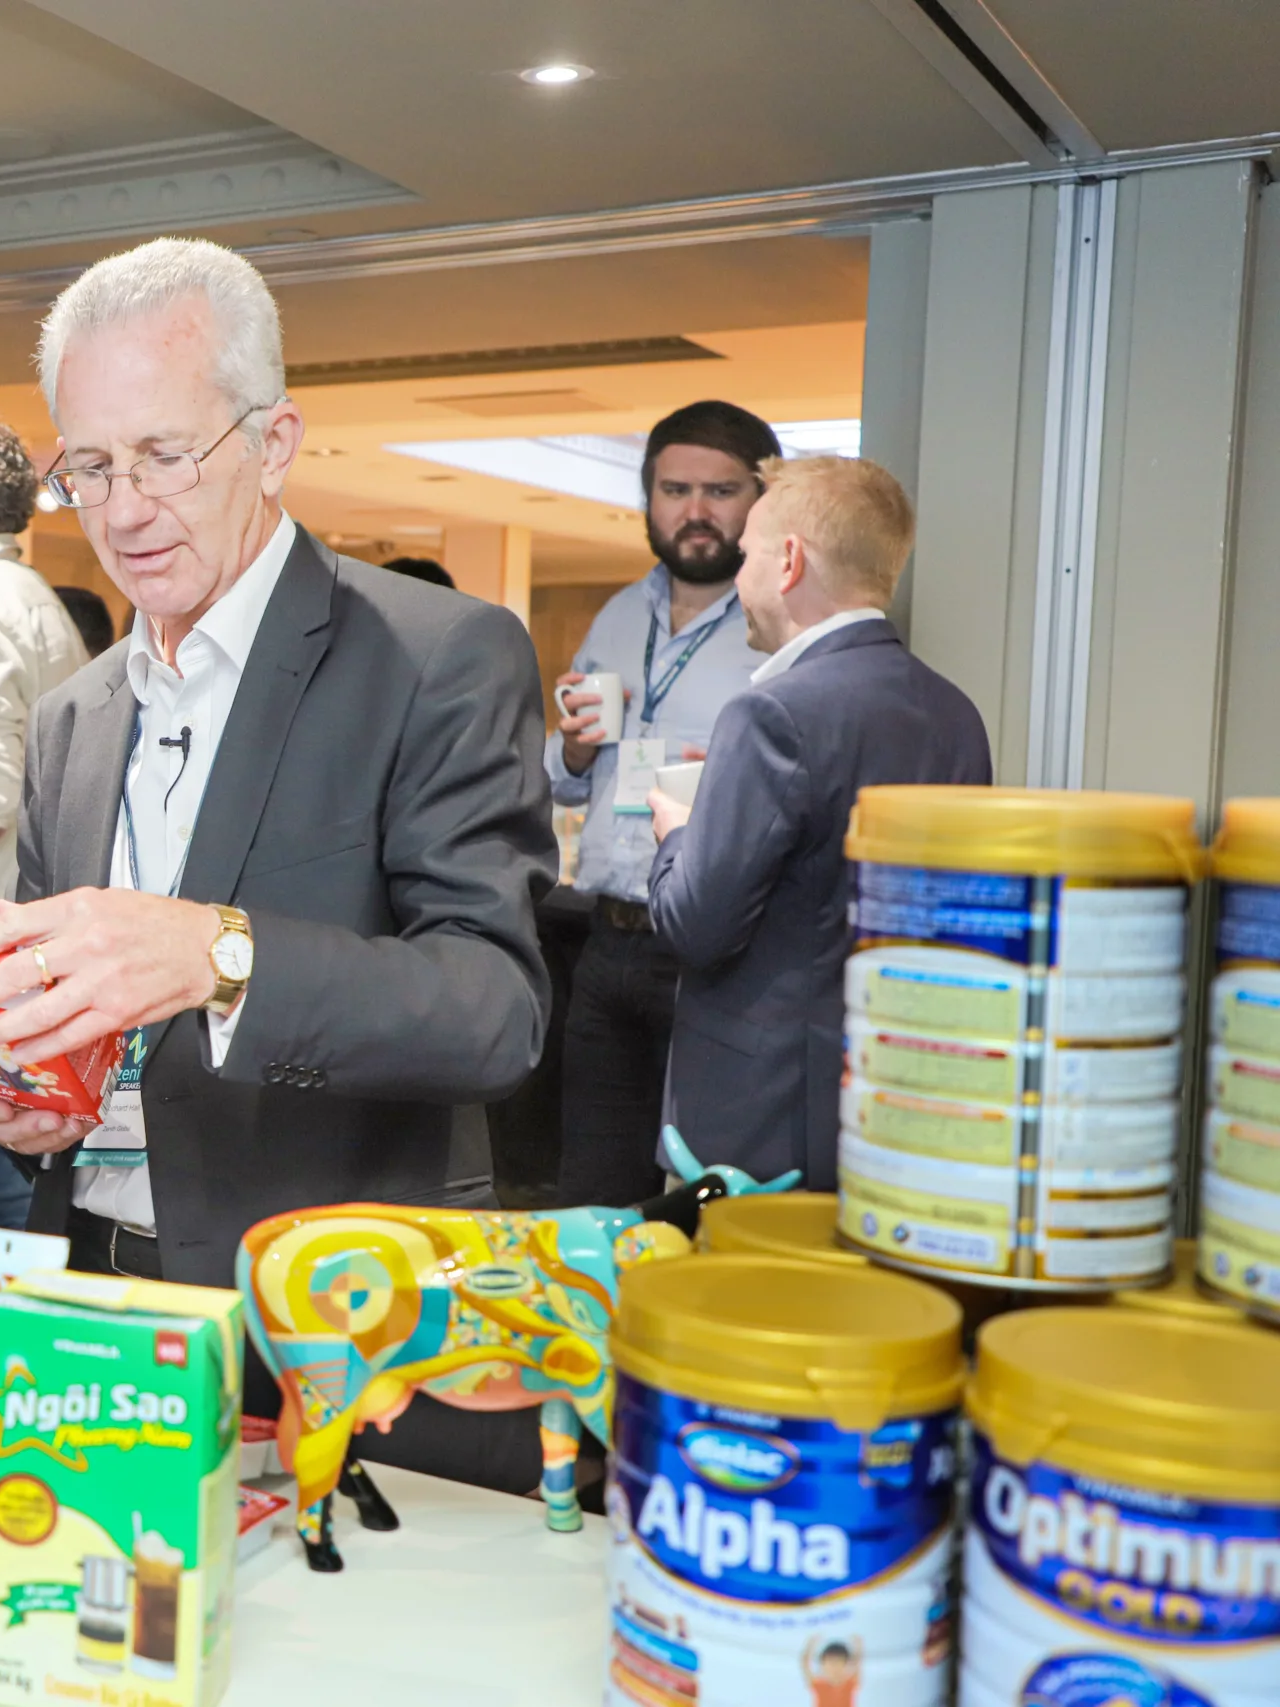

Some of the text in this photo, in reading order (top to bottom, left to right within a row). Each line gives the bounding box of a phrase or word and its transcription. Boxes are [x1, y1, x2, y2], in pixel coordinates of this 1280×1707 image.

[117, 1064, 142, 1081] zeni
[5, 1383, 187, 1432] Ngôi Sao
[689, 1433, 785, 1476] dielac
[637, 1474, 851, 1580] Alpha
[1055, 1569, 1205, 1633] GOLD
